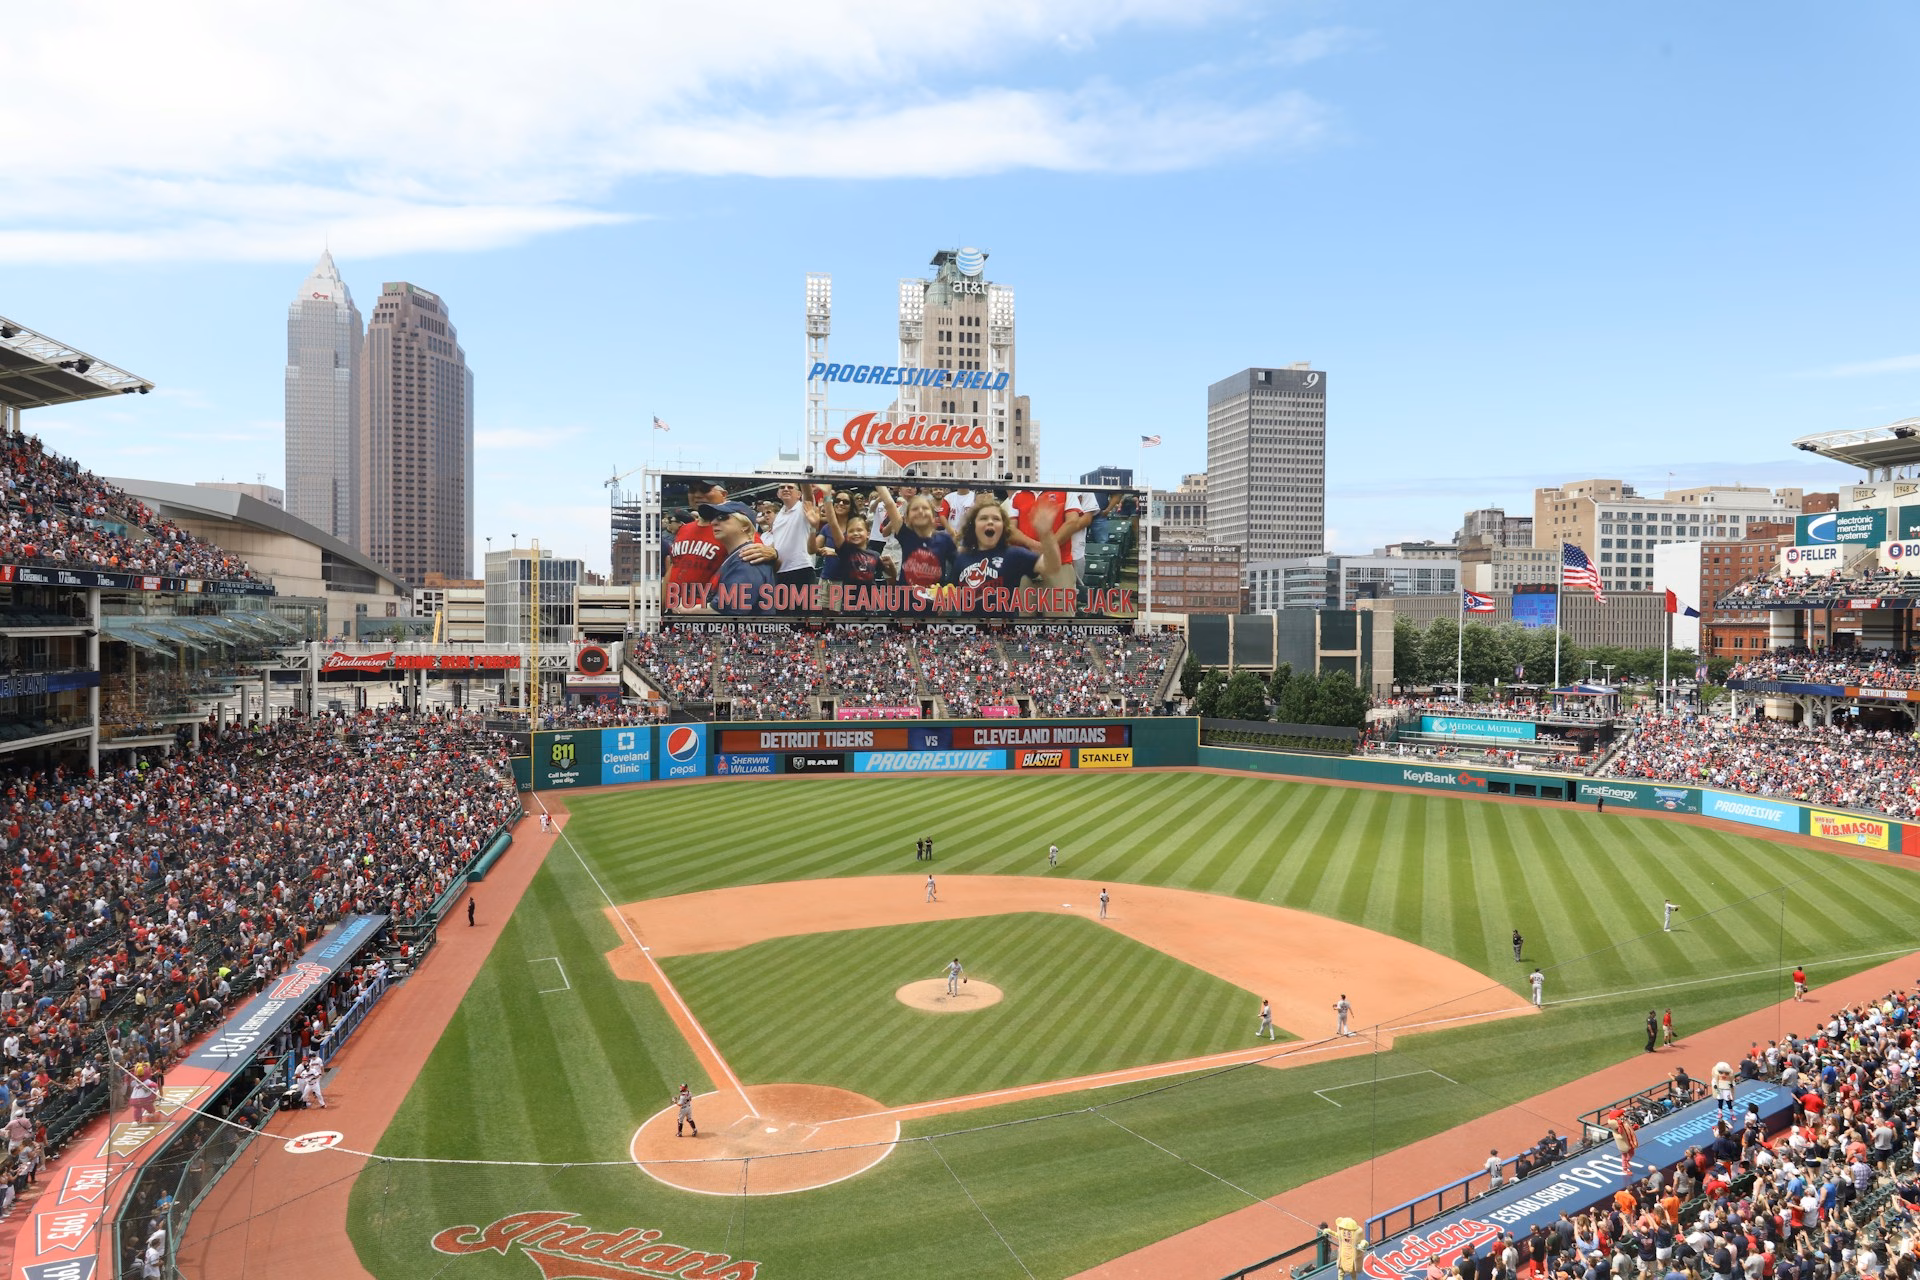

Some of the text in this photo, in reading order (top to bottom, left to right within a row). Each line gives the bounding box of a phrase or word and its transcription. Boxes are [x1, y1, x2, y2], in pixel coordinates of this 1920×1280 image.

[953, 280, 988, 295] at&t
[807, 362, 1010, 391] PROGRESSIVE FIELD
[825, 411, 993, 464] Indians
[1837, 515, 1873, 525] electronic
[1837, 524, 1872, 533] merchant
[671, 540, 720, 560] INDIANS
[1801, 548, 1836, 560] FELLER
[665, 582, 1134, 613] BUY ME SOME PEANUTS AND CRACKER JACK
[674, 622, 706, 633] START
[708, 623, 735, 633] DEAD
[1015, 625, 1043, 633] START
[328, 655, 387, 668] Budweiser
[395, 655, 520, 669] HOME RUN PORCH
[1859, 688, 1907, 699] DETROIT TIGERS
[1449, 722, 1523, 734] MEDICAL MUTUAL
[760, 727, 1106, 748] DETROIT TIGERS VS CLEVELAND INDIANS
[552, 743, 575, 761] 811
[1022, 752, 1062, 768] BLASTER
[1082, 753, 1129, 763] STANLEY
[603, 750, 649, 774] Cleveland Clinic
[731, 756, 769, 765] SHERWIN
[866, 752, 992, 769] PROGRESSIVE
[548, 771, 560, 779] Call
[670, 765, 696, 776] pepsi
[1403, 769, 1456, 785] KeyBank
[1581, 784, 1636, 799] FirstEnergy
[1714, 800, 1785, 822] PROGRESSIVE
[269, 962, 331, 1000] Indians
[201, 1031, 260, 1058] 1901
[113, 1126, 154, 1147] 1948
[71, 1167, 113, 1192] 1954
[1490, 1181, 1580, 1225] ESTABLISHED
[47, 1212, 88, 1240] 1995
[431, 1211, 762, 1280] Indians
